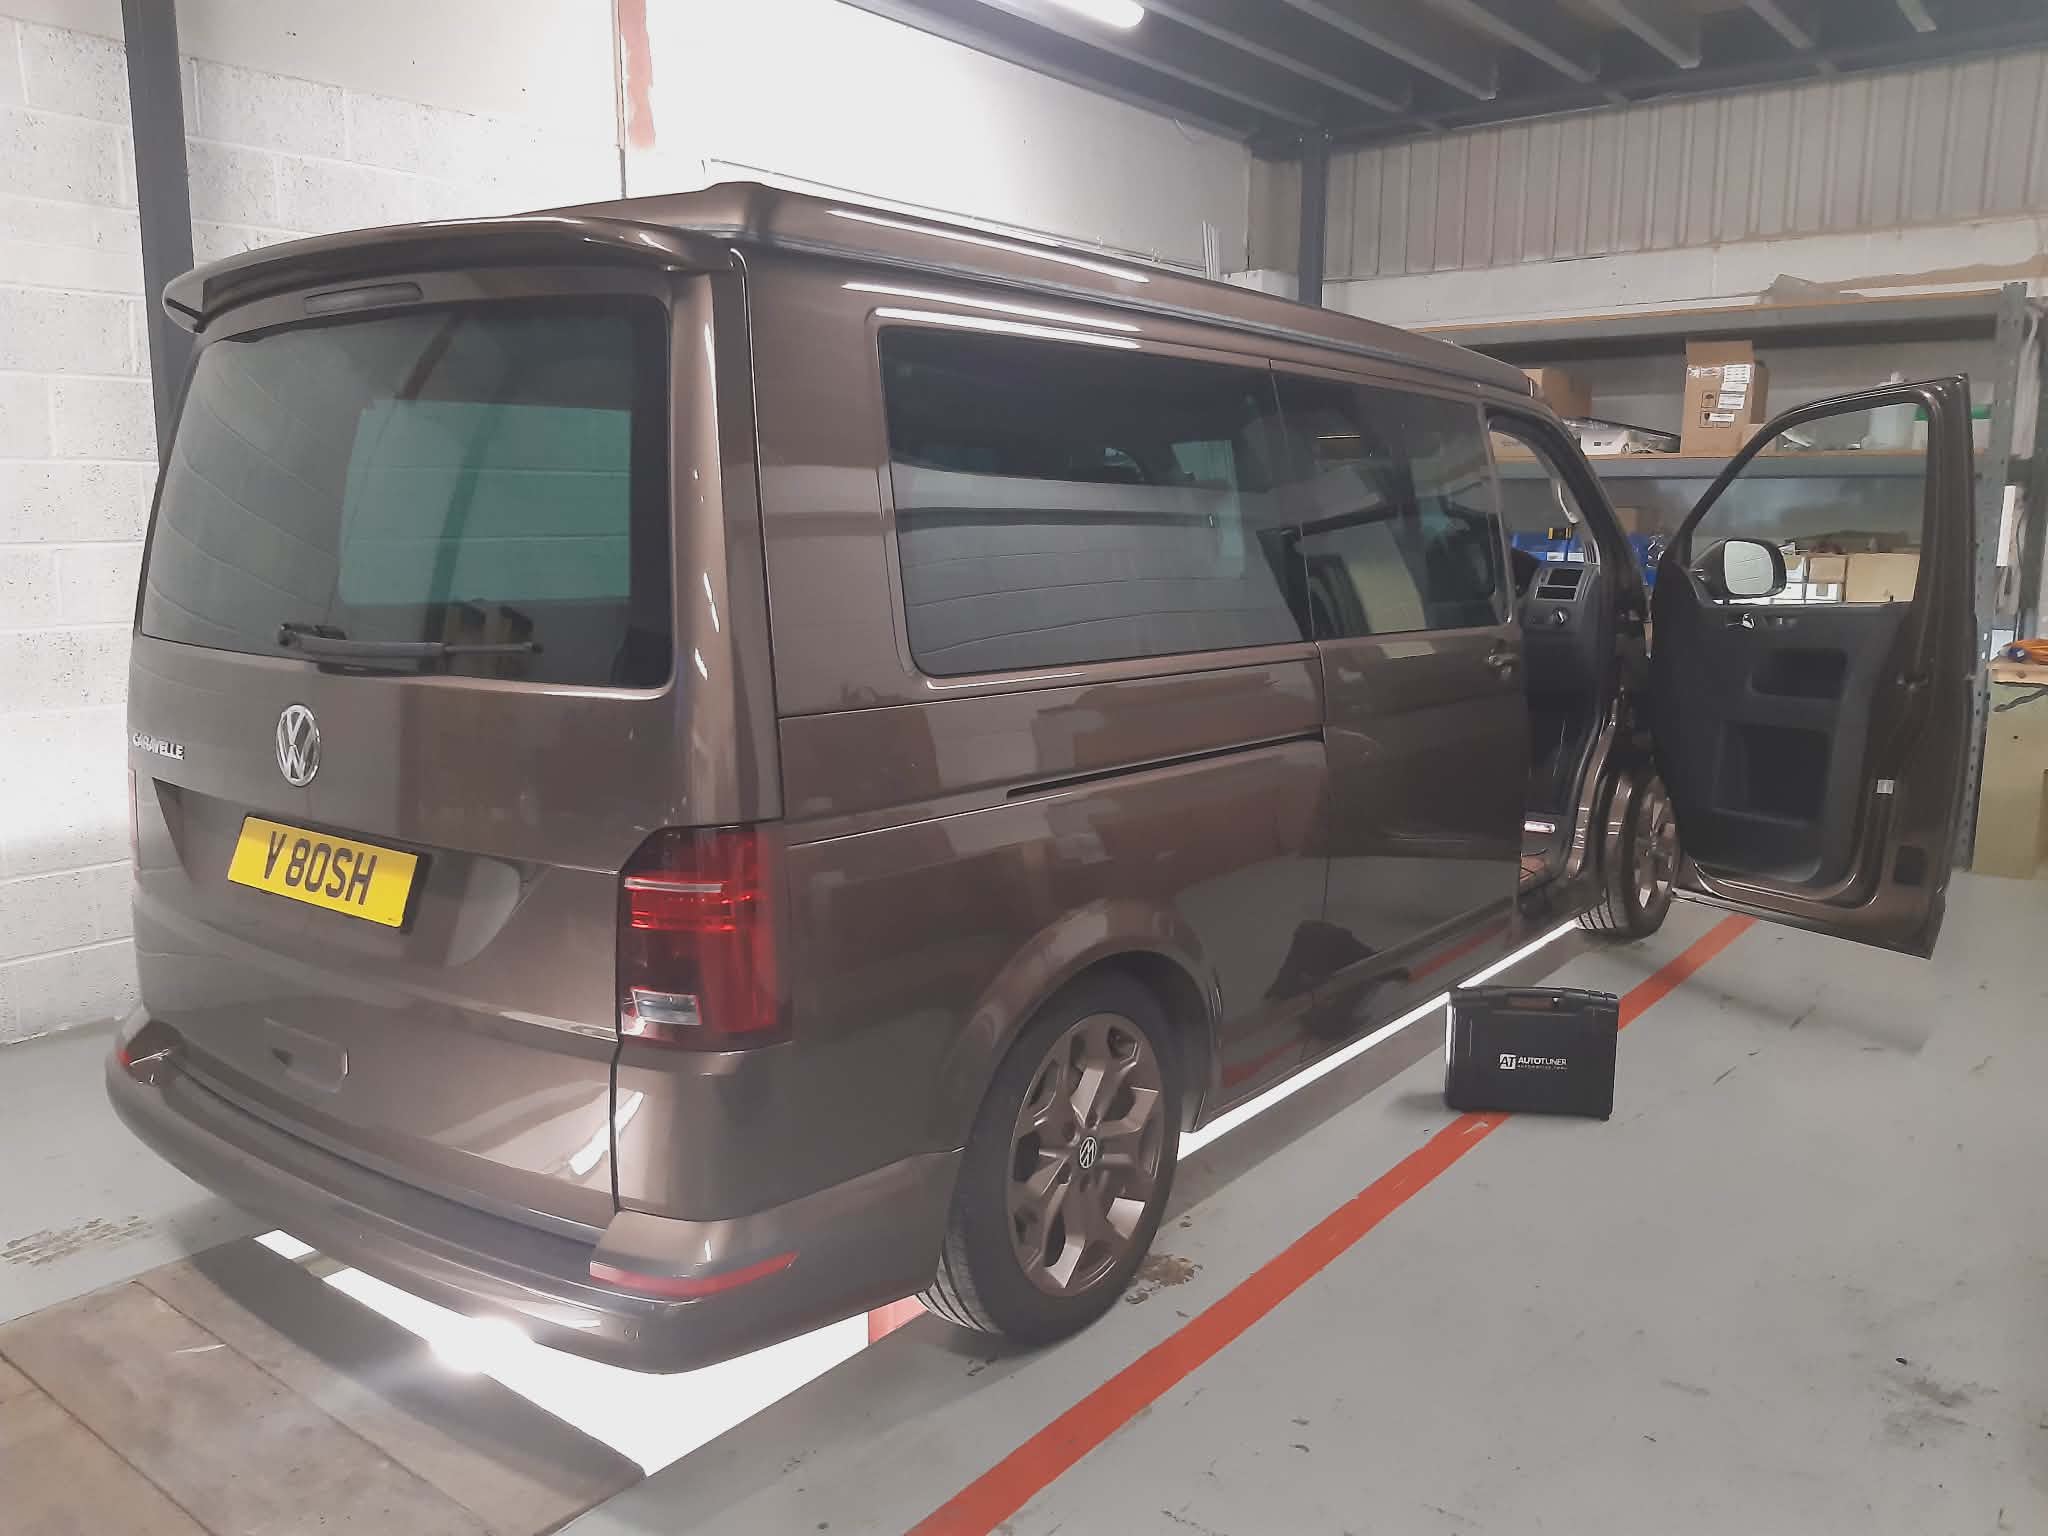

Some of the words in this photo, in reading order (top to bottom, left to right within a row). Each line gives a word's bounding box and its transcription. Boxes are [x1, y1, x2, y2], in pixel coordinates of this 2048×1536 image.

[275, 704, 321, 787] VW
[264, 830, 288, 880] V
[1499, 1053, 1517, 1070] AT
[1518, 1056, 1567, 1066] AUTOTUNER
